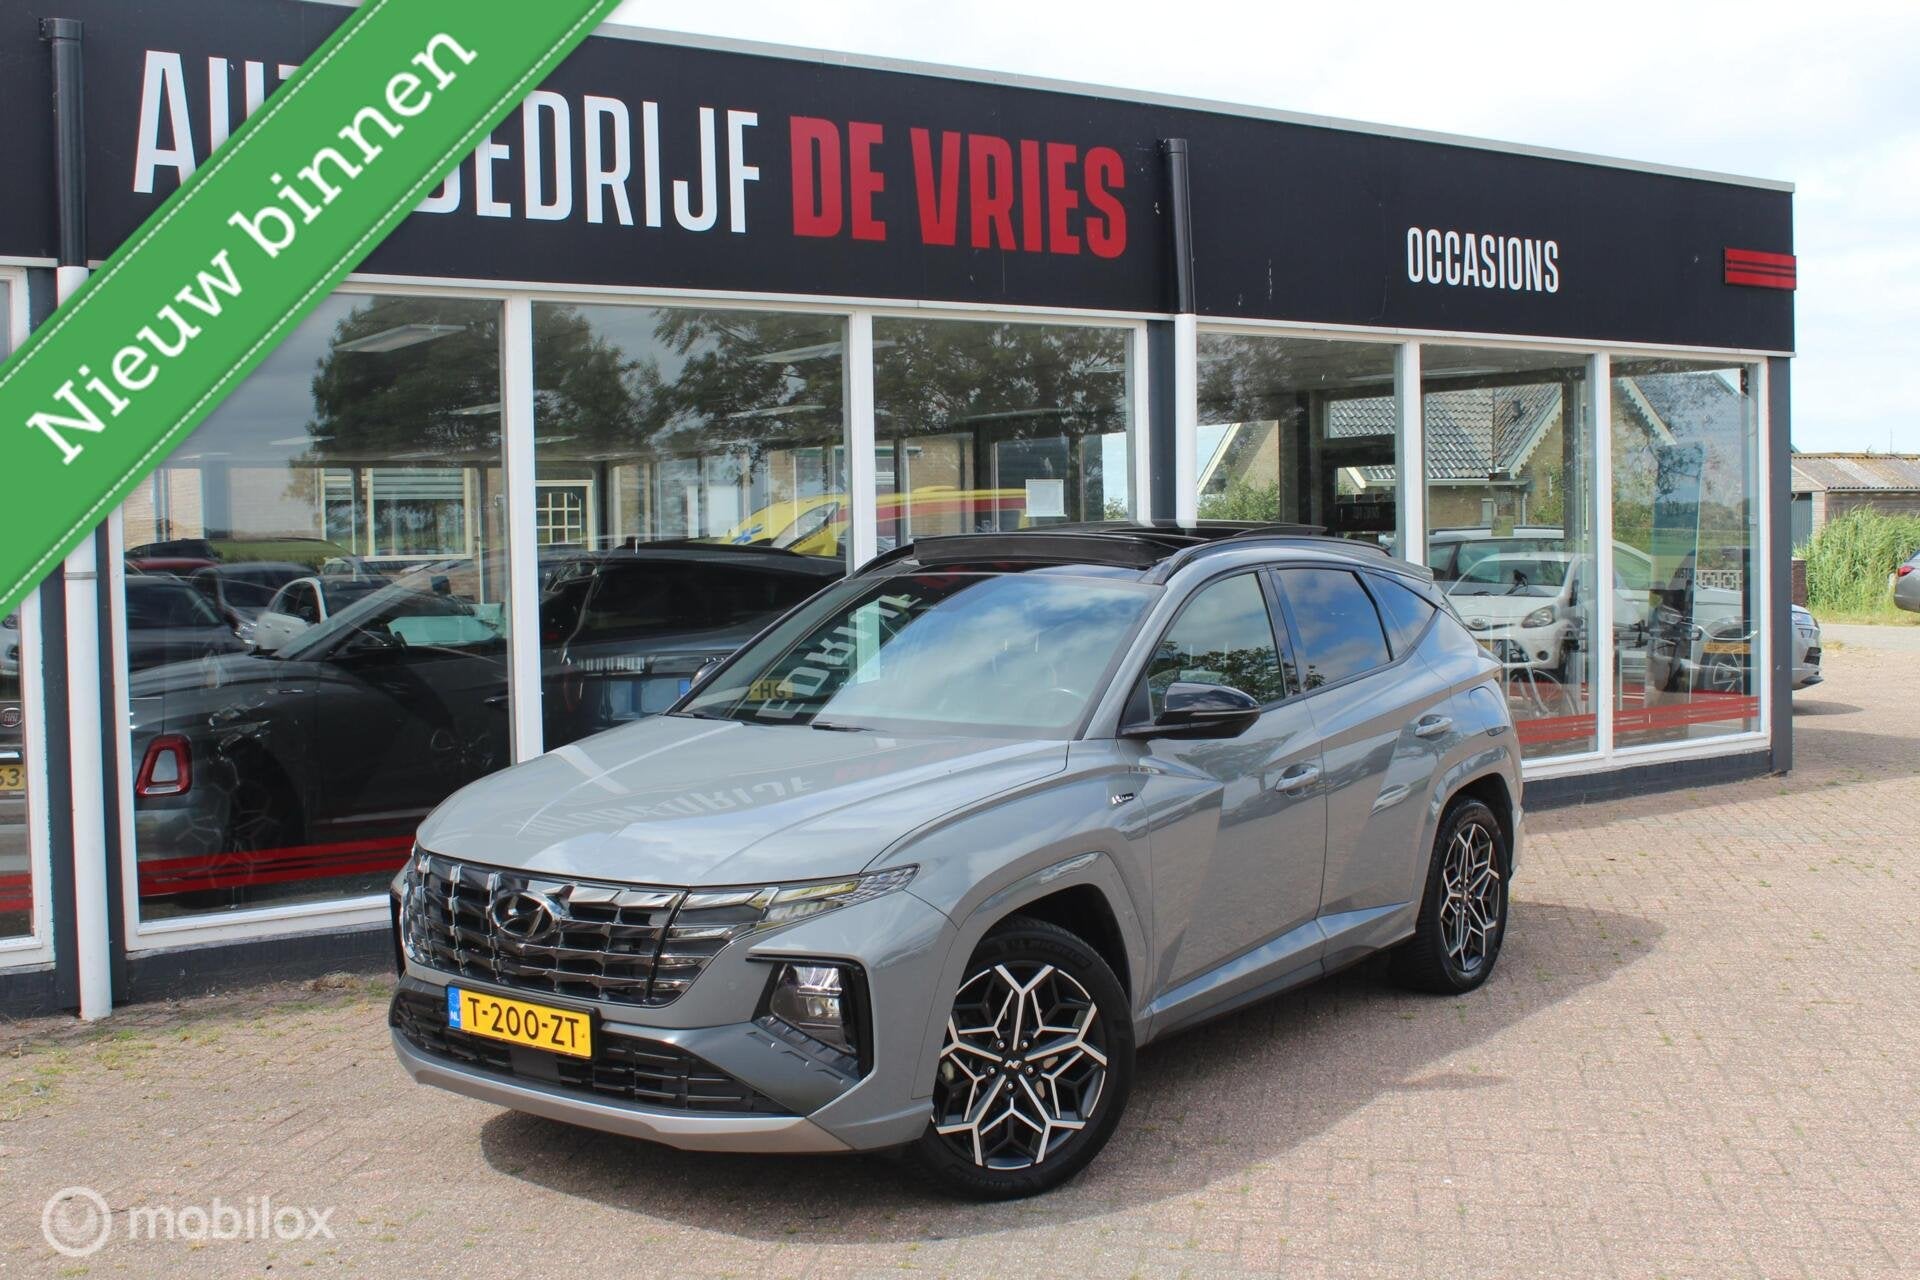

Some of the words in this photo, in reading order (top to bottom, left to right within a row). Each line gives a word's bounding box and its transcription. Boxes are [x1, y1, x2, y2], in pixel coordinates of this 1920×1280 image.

[134, 50, 760, 233] AEDRIJF
[789, 115, 886, 241] DE
[910, 127, 1127, 258] VRIES
[1407, 226, 1560, 293] OCCASIONS
[450, 1010, 460, 1022] NL
[467, 997, 580, 1049] T-200-ZT
